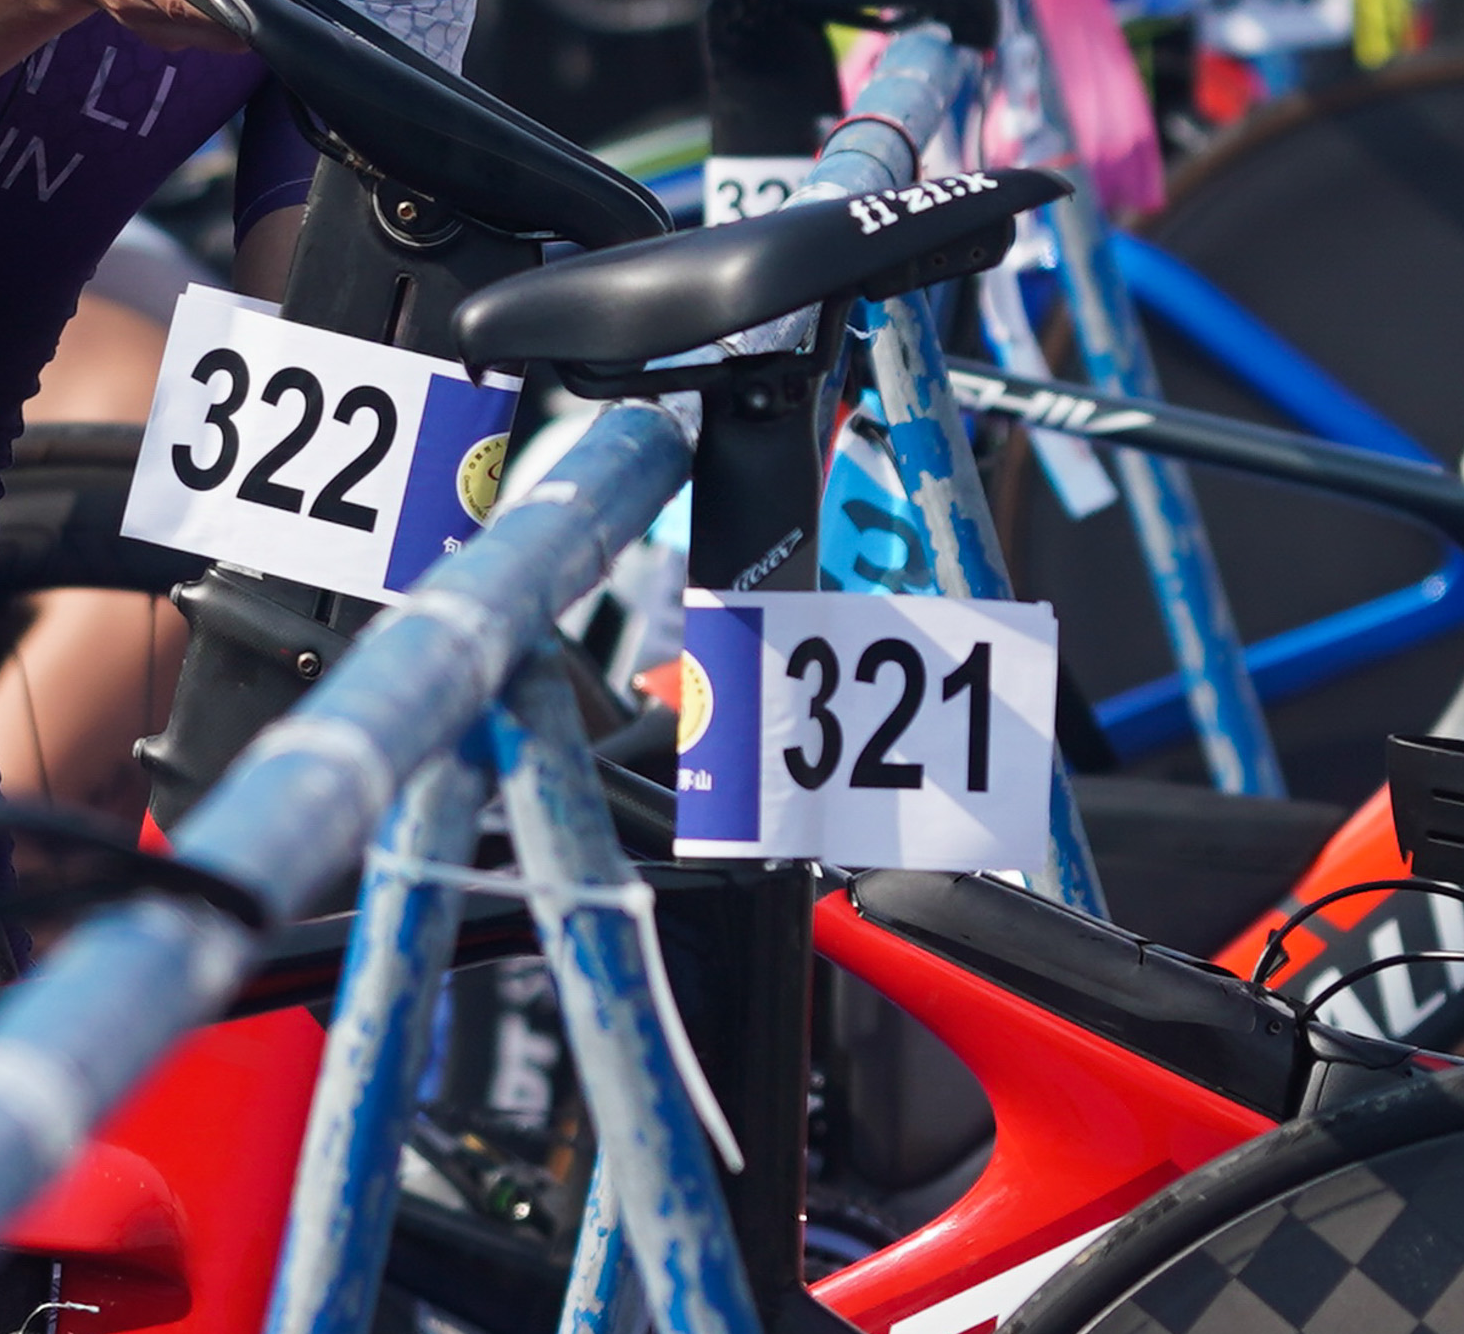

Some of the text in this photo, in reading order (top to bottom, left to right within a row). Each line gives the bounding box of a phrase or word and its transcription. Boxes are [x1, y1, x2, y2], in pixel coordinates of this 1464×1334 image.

[716, 179, 794, 223] 32
[171, 345, 399, 533] 322
[782, 635, 995, 794] 321
